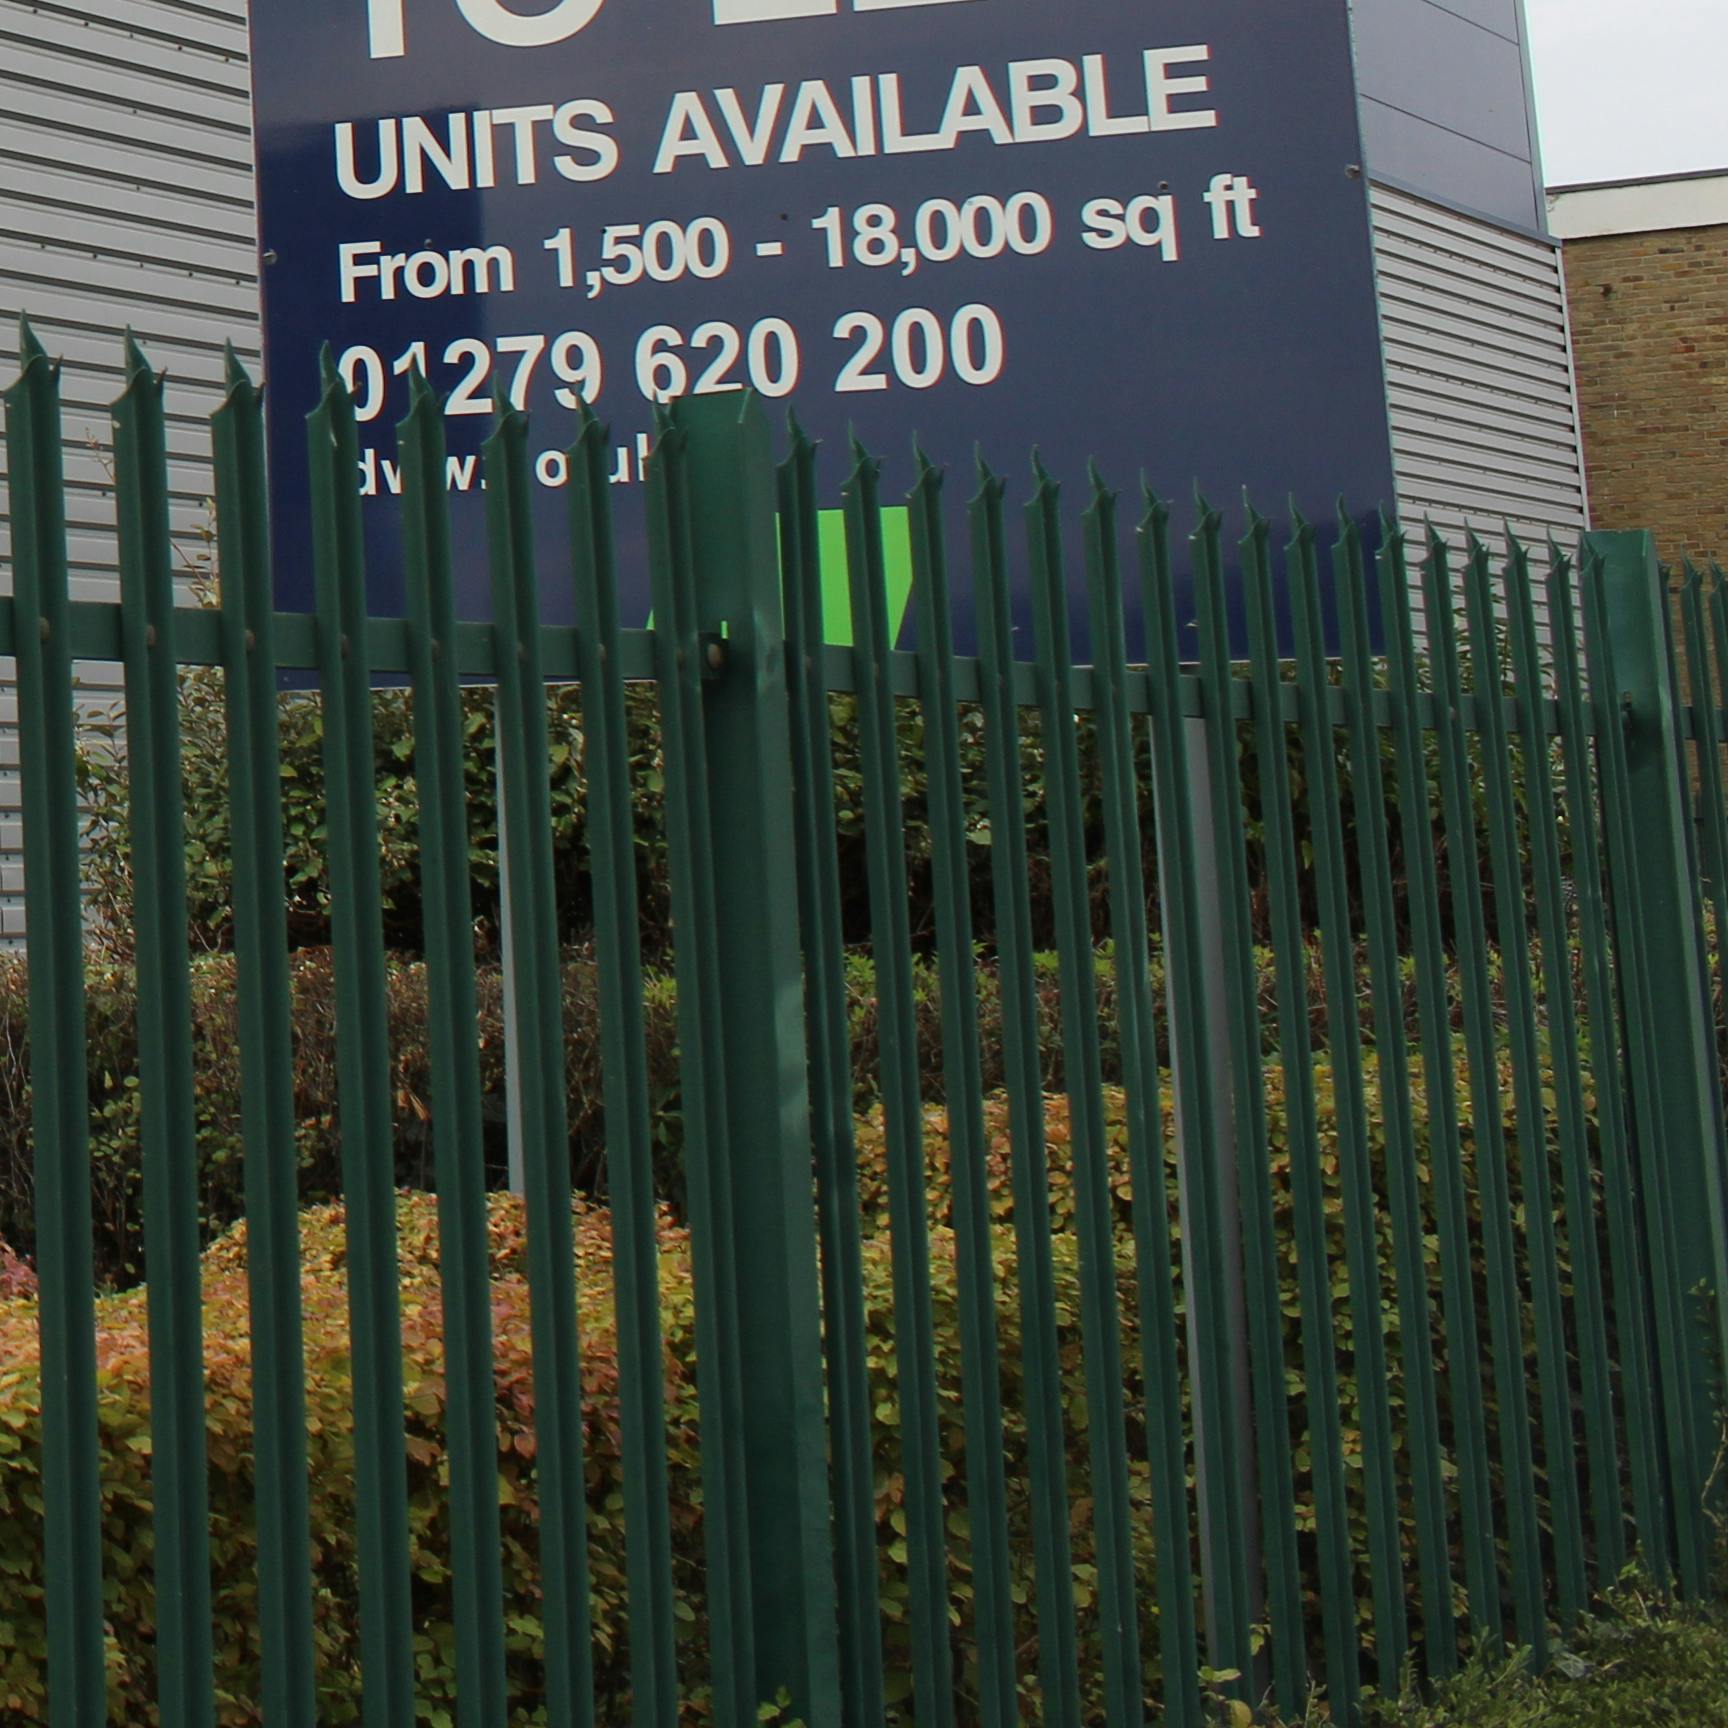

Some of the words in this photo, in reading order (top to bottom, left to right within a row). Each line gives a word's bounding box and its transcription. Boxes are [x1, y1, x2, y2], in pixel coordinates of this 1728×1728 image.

[335, 99, 619, 200] UNITS
[653, 44, 1218, 174] AVAILABLE
[339, 240, 515, 304] From
[544, 217, 730, 299] 1,500
[756, 241, 783, 257] -
[812, 190, 1053, 276] 18,000
[1082, 194, 1179, 263] sq
[1203, 173, 1260, 240] ft
[635, 317, 798, 404] 620
[833, 303, 1004, 392] 200
